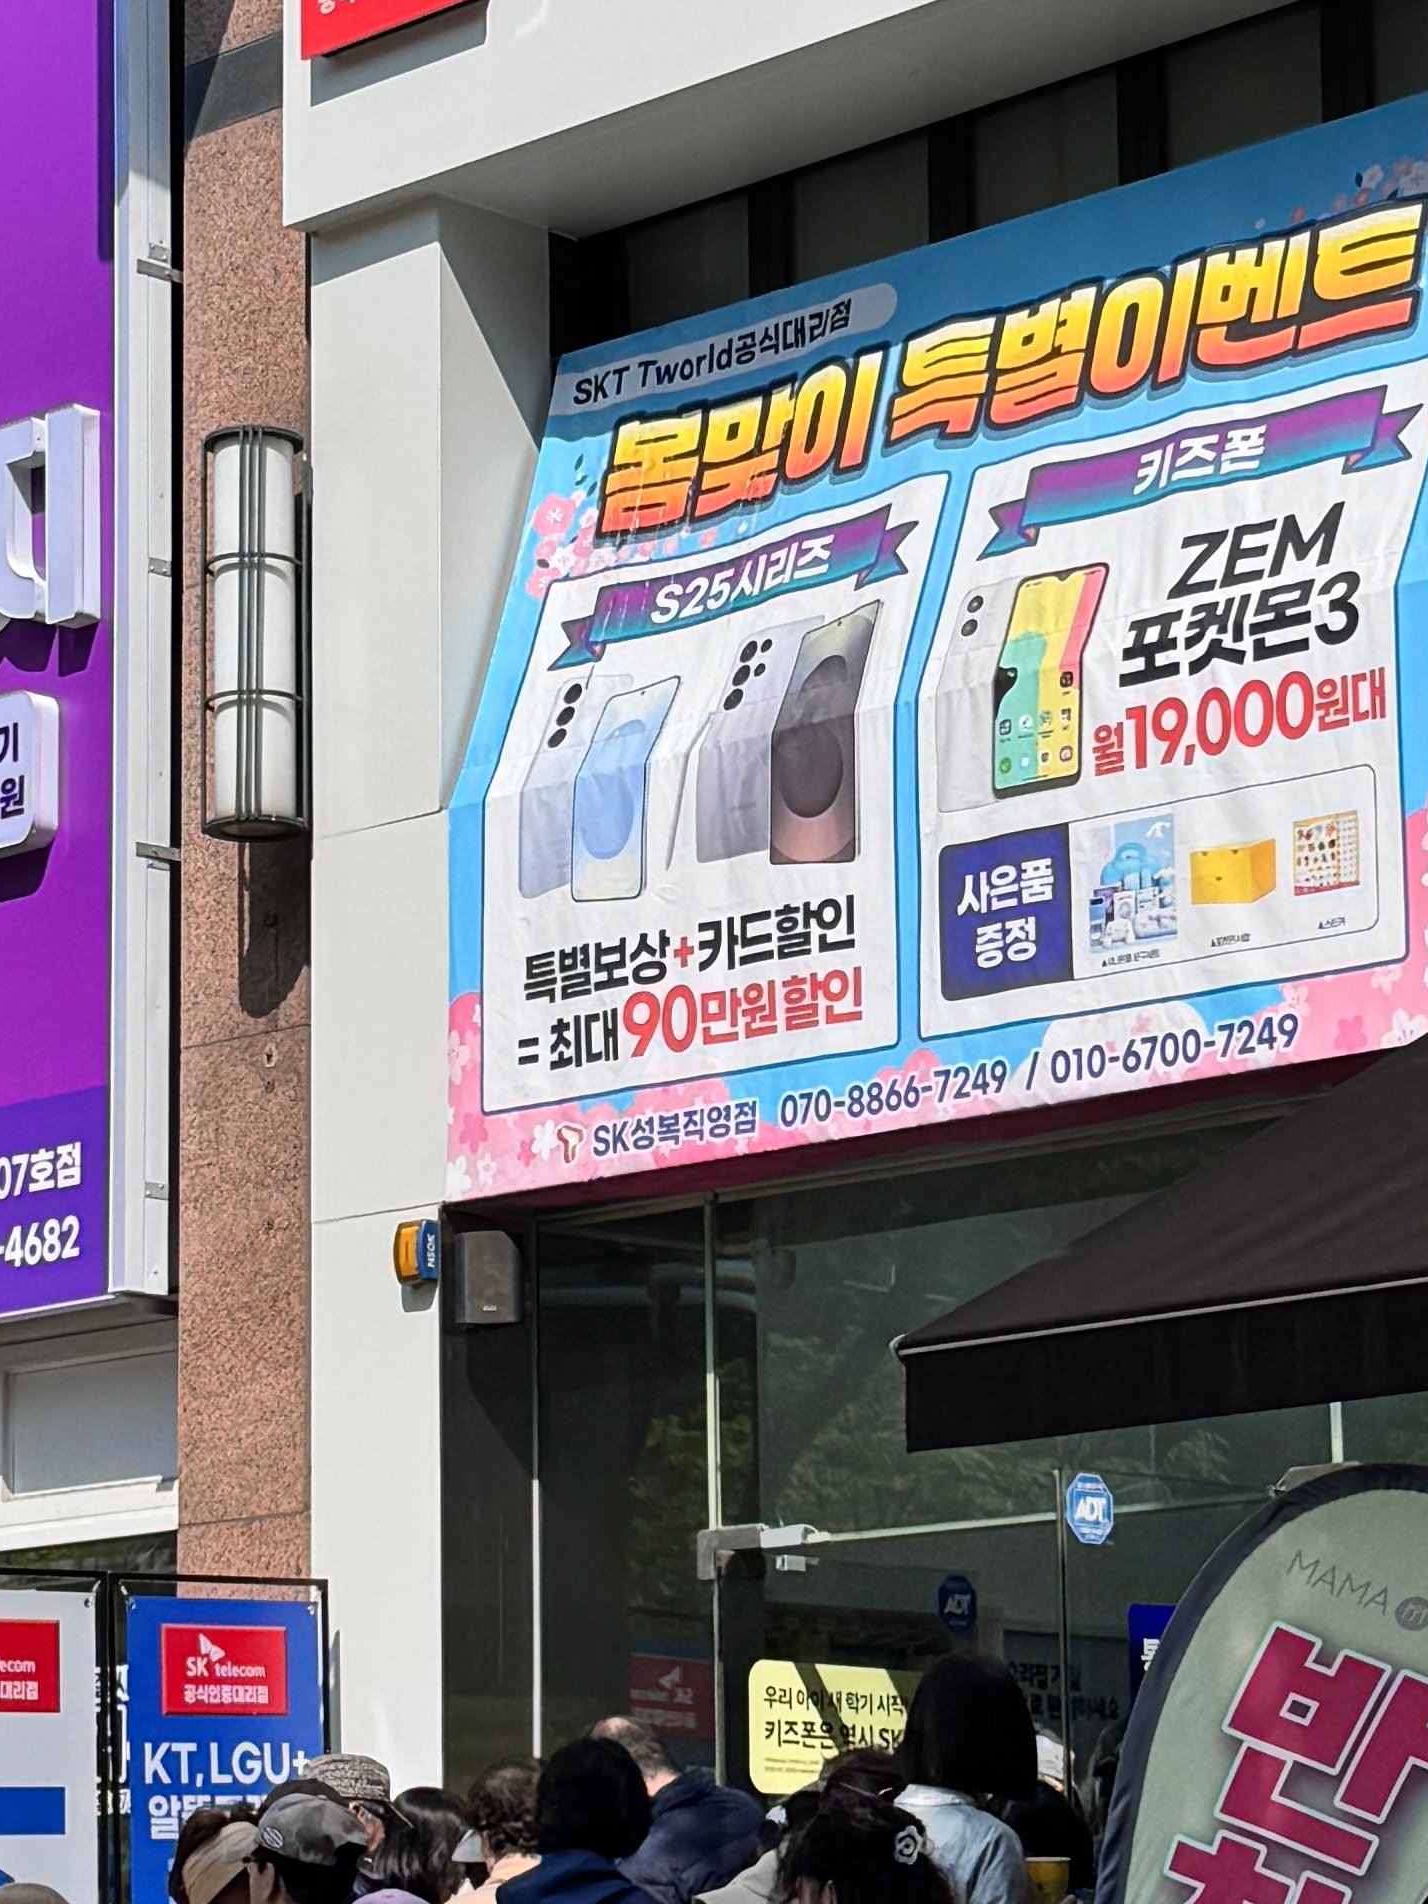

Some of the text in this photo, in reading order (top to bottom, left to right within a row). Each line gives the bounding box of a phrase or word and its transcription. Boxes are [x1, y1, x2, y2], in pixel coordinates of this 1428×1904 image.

[572, 365, 631, 406] SKT
[600, 202, 1426, 534] 봄맞이 특별이벤트
[1133, 424, 1266, 497] 키즈폰
[650, 533, 835, 625] S25시리즈
[1166, 501, 1345, 602] ZEM
[1118, 570, 1361, 689] 포켓몬3
[1092, 666, 1387, 777] 월19,000원대
[957, 857, 1056, 916] 사은품
[974, 917, 1039, 970] 증정
[783, 966, 864, 1031] 할인
[592, 1100, 758, 1158] SK성복직영점
[780, 1058, 1008, 1129] 070-8866-7249
[1050, 1012, 1300, 1085] 010-6700-7249
[1074, 1495, 1108, 1523] ADT
[1286, 1549, 1389, 1617] MAMA
[185, 1656, 267, 1679] SK telecom
[763, 1685, 793, 1711] 우리
[845, 1691, 873, 1715] 학기
[764, 1718, 834, 1751] 키즈폰은
